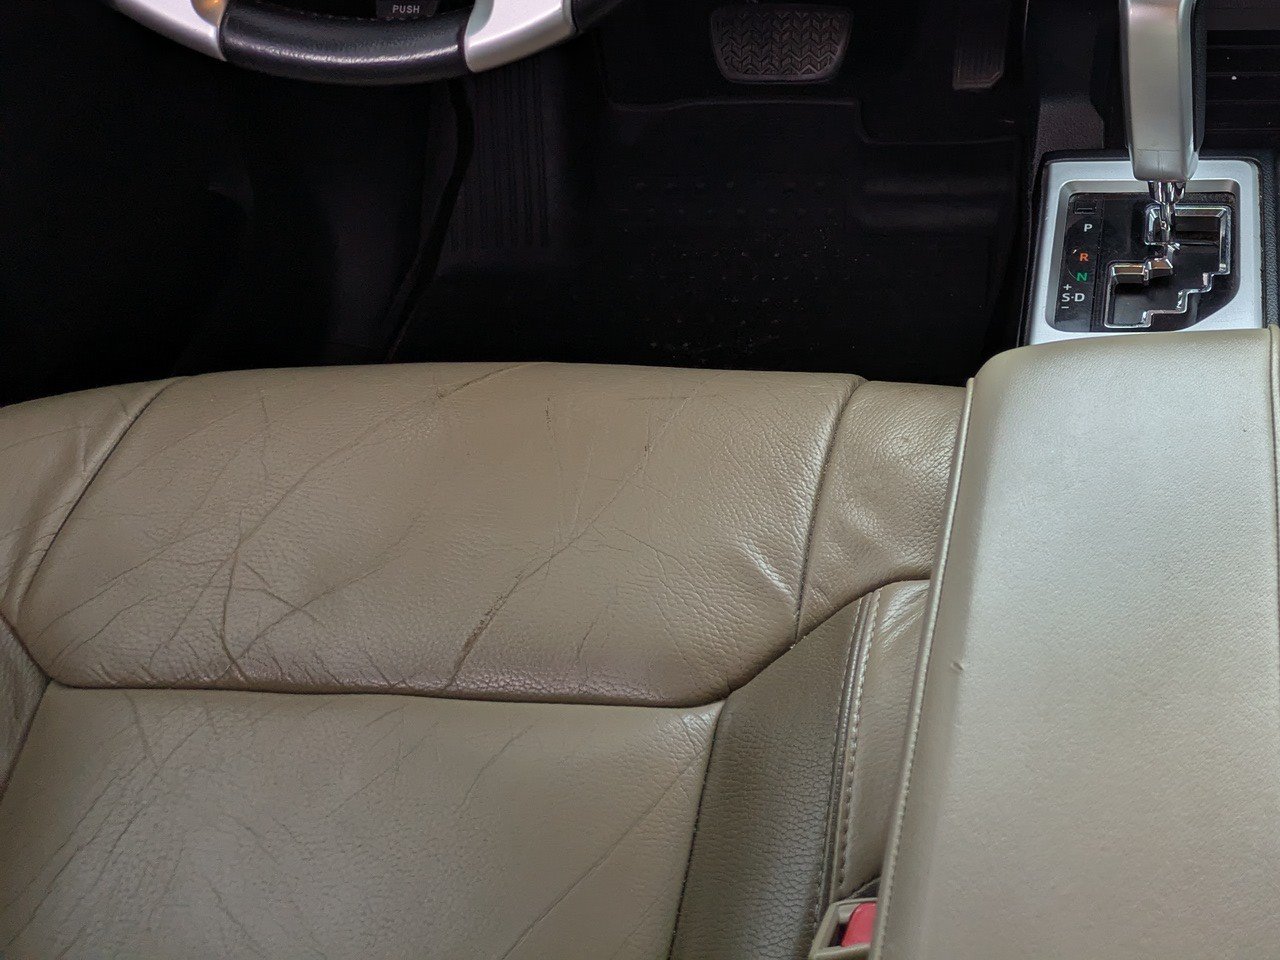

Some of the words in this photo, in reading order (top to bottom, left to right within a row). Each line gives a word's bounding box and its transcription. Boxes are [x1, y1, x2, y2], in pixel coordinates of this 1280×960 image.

[392, 4, 420, 14] PUSH
[1083, 223, 1093, 232] P
[1079, 253, 1089, 262] R
[1076, 272, 1088, 282] N
